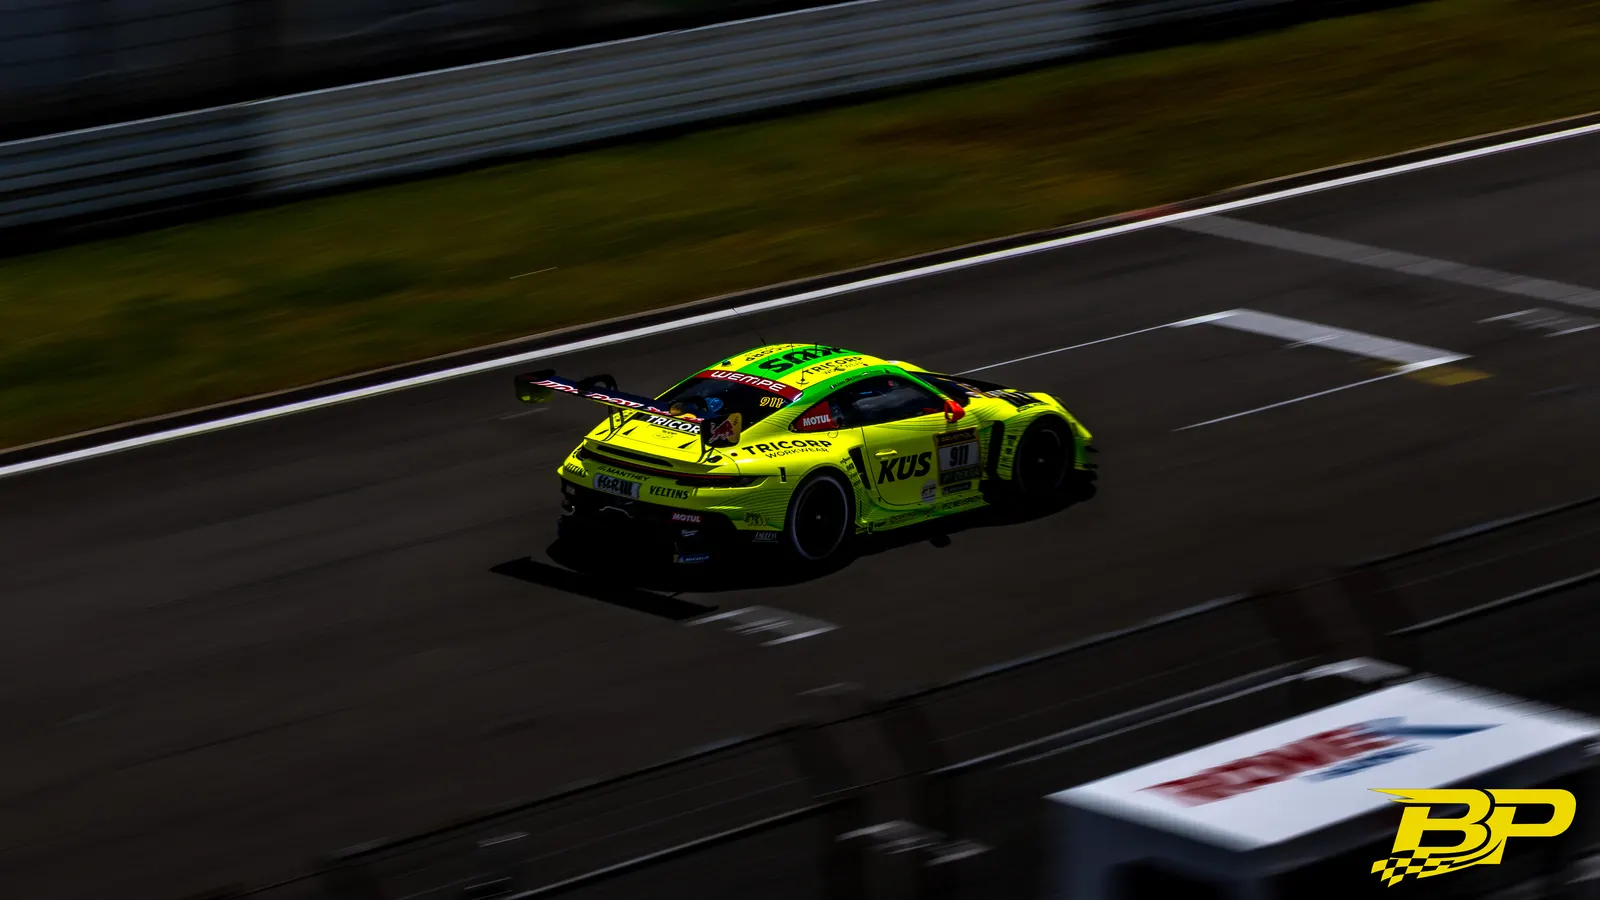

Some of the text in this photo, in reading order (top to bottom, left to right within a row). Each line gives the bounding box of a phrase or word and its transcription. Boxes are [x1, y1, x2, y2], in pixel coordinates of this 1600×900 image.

[710, 370, 787, 392] WEMPE
[759, 396, 783, 409] 911
[802, 413, 832, 427] MOTUL
[741, 440, 832, 455] TRICORP
[950, 444, 969, 467] 911
[605, 466, 649, 481] MANTHEY
[649, 484, 689, 500] VELTINS
[671, 511, 701, 523] MOTUL
